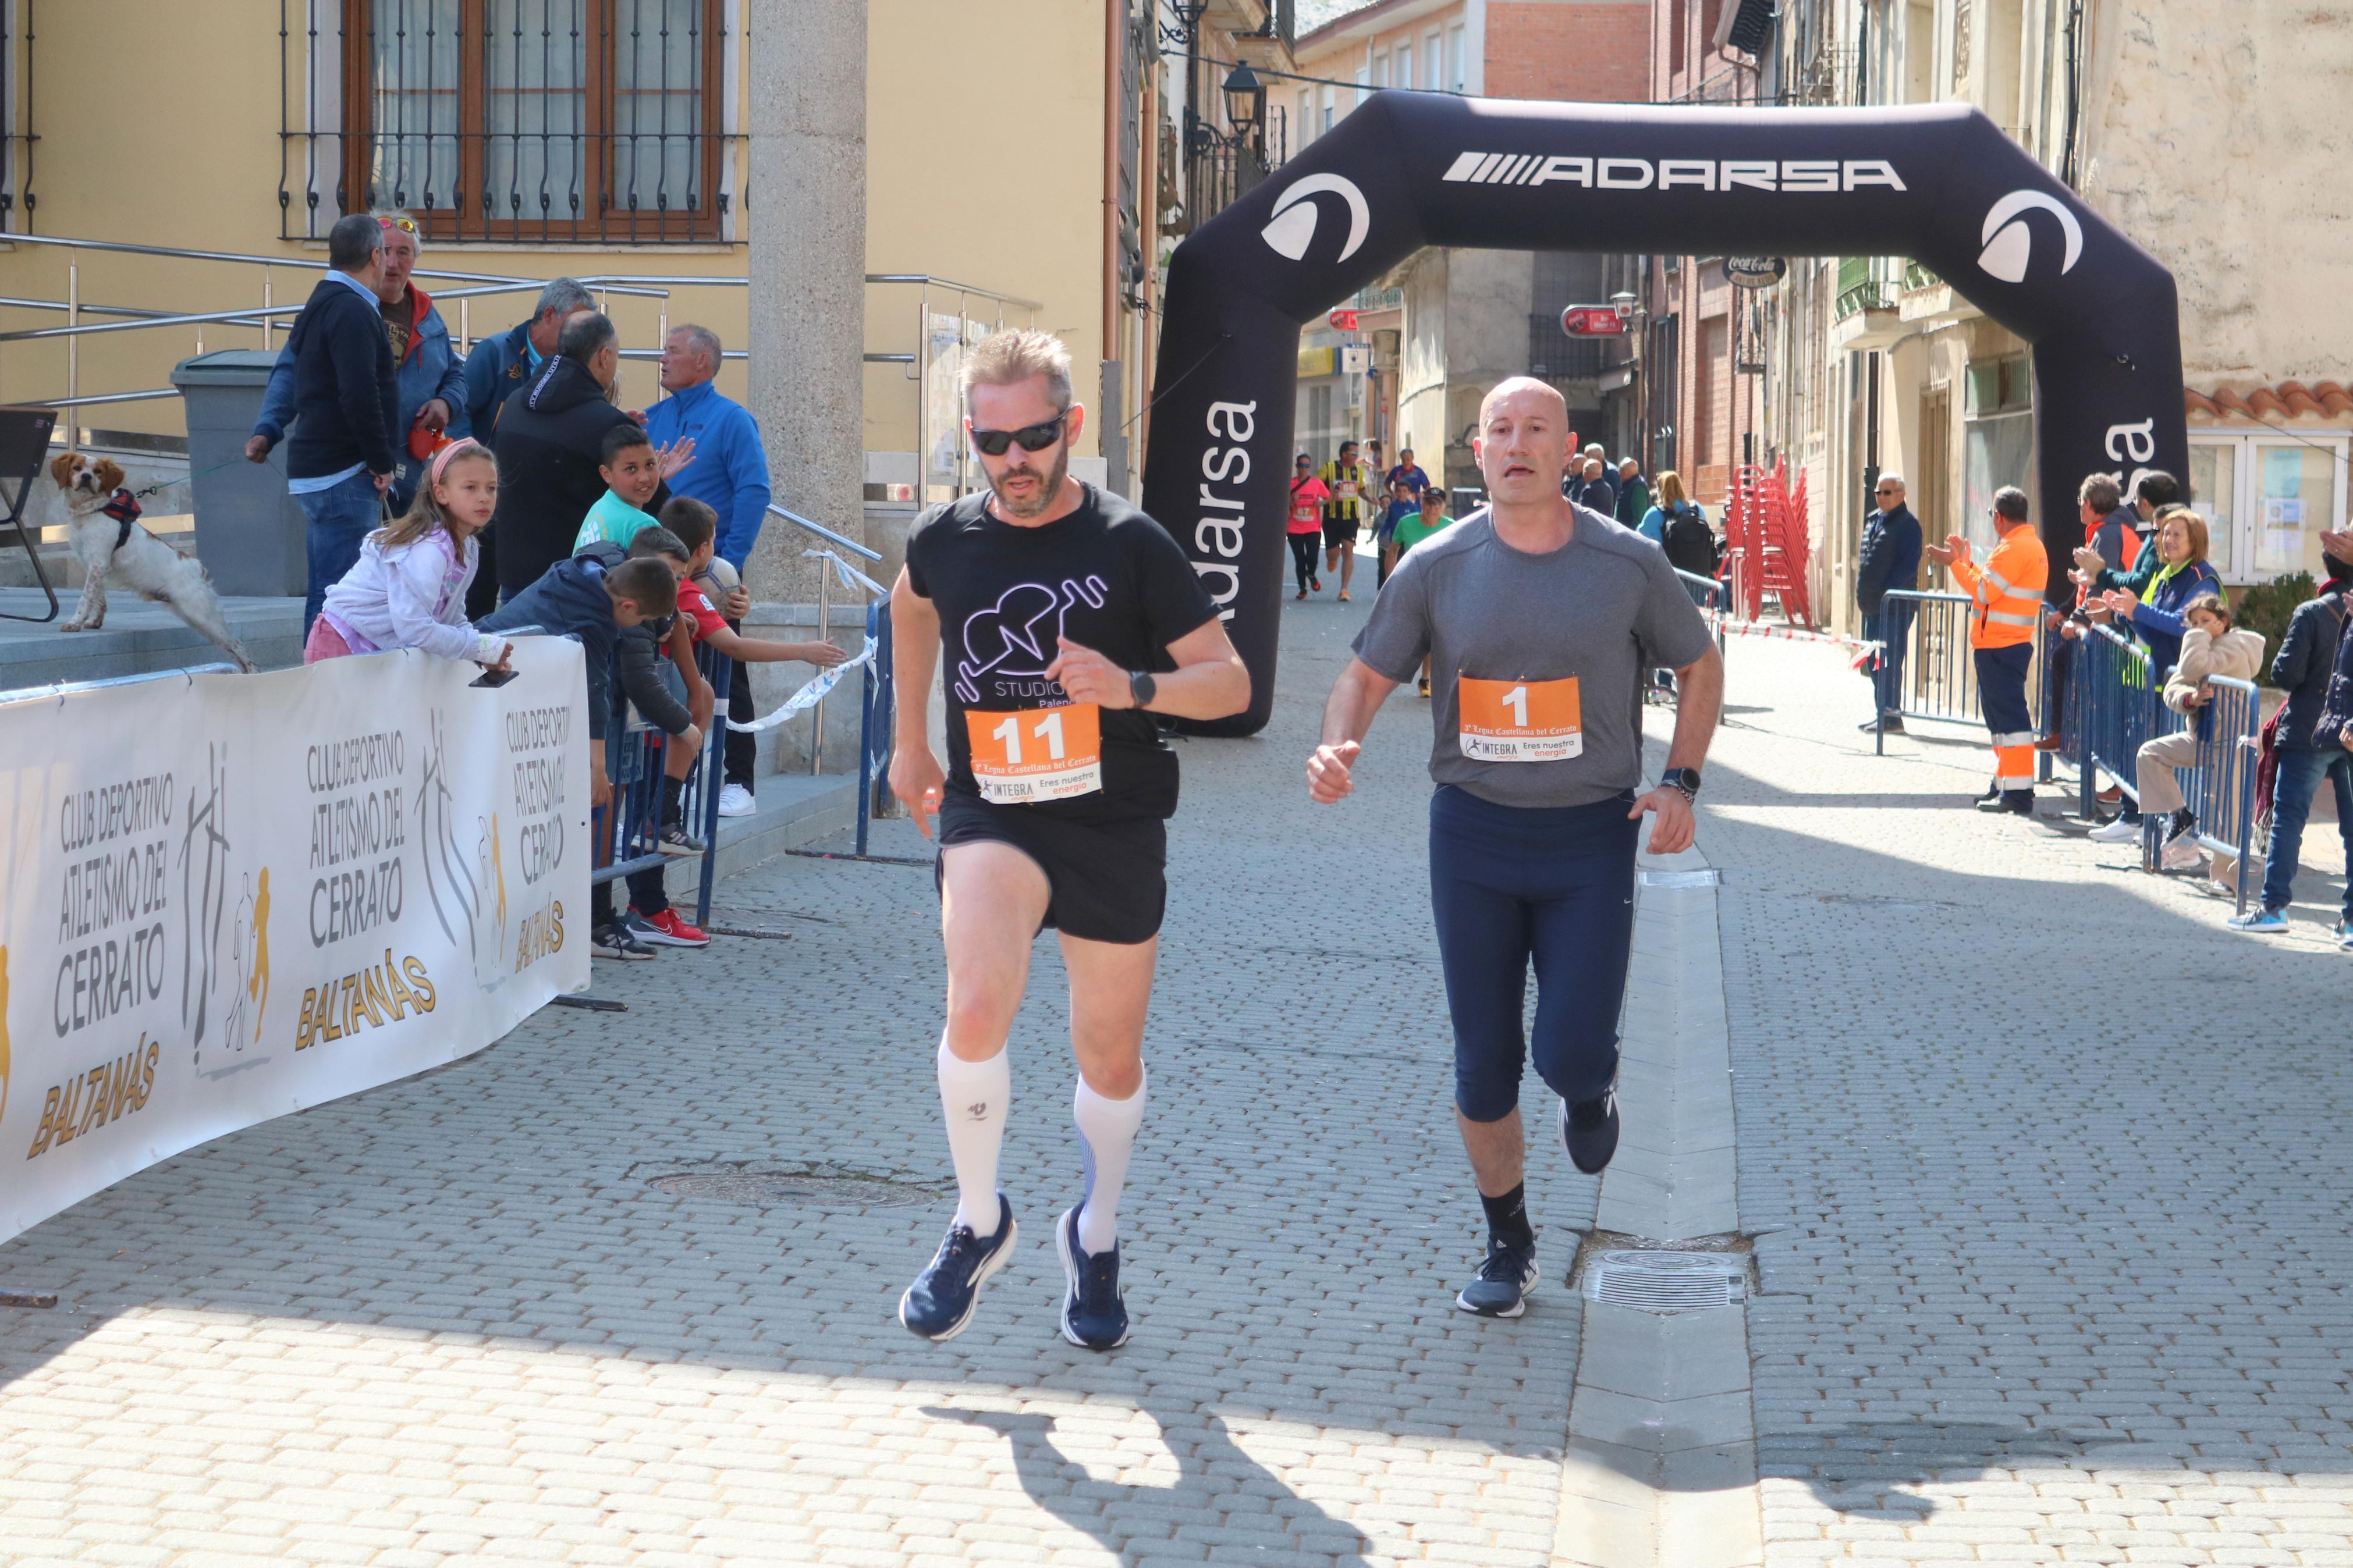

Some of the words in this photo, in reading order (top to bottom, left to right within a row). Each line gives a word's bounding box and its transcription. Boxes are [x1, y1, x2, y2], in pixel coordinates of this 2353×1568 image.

[1529, 155, 1907, 191] ADARSA
[995, 681, 1064, 697] STUDIO
[1502, 687, 1527, 727] 1
[506, 711, 529, 753] CLUB
[993, 713, 1064, 764] 11
[1482, 742, 1517, 755] INTEGRA
[1543, 739, 1574, 749] nuestra
[1549, 726, 1577, 735] Cerrato
[307, 743, 341, 794] CLUB
[343, 730, 403, 786] DEPORTIVO
[1007, 763, 1051, 774] Castellana
[1054, 759, 1066, 769] del
[1067, 755, 1096, 767] Cerrato
[1062, 772, 1094, 785] nuestra
[993, 783, 1034, 796] INTEGRA
[61, 790, 94, 853] CLUB
[99, 772, 173, 842] DEPORTIVO
[310, 792, 380, 869] ATLETISMO
[384, 787, 404, 849] DEL
[59, 847, 139, 944] ATLETISMO
[143, 840, 167, 915] DEL
[310, 856, 402, 948] CERRATO
[55, 922, 164, 1038] CERRATO
[296, 948, 435, 1051] BALTANÁS
[26, 1031, 159, 1161] BALTANÁS
